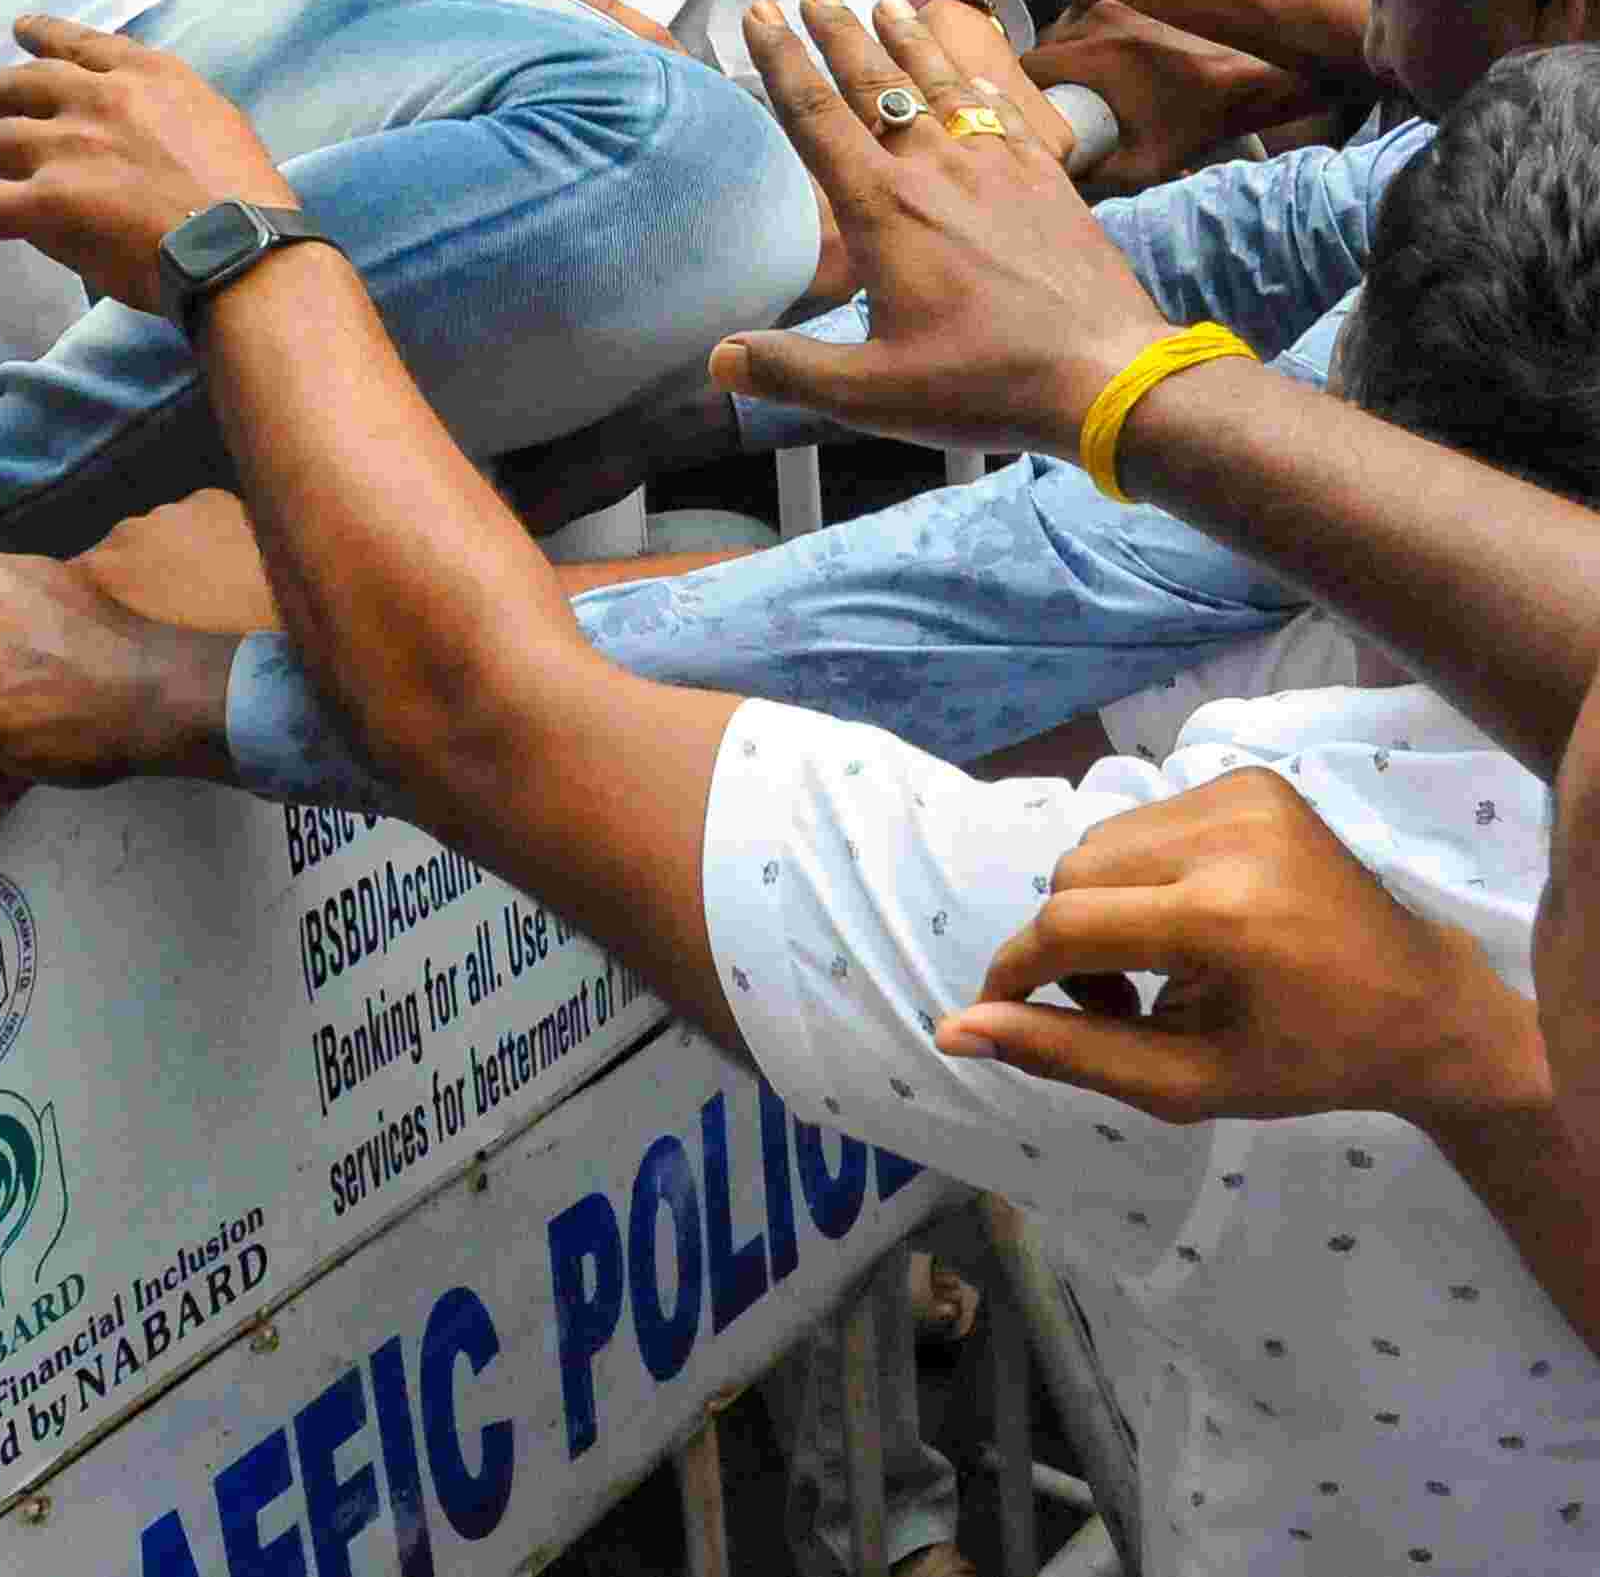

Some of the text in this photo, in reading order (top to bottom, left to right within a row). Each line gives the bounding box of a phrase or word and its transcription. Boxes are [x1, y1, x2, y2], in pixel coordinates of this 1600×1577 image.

[425, 958, 460, 1032] for
[465, 921, 503, 1006] all.
[504, 902, 548, 977] Use
[330, 1102, 429, 1216] services
[432, 1071, 465, 1143] for
[470, 985, 591, 1116] betterment
[133, 1207, 264, 1313] Inclusion
[29, 1389, 68, 1441] by
[75, 1244, 269, 1412] NABARD
